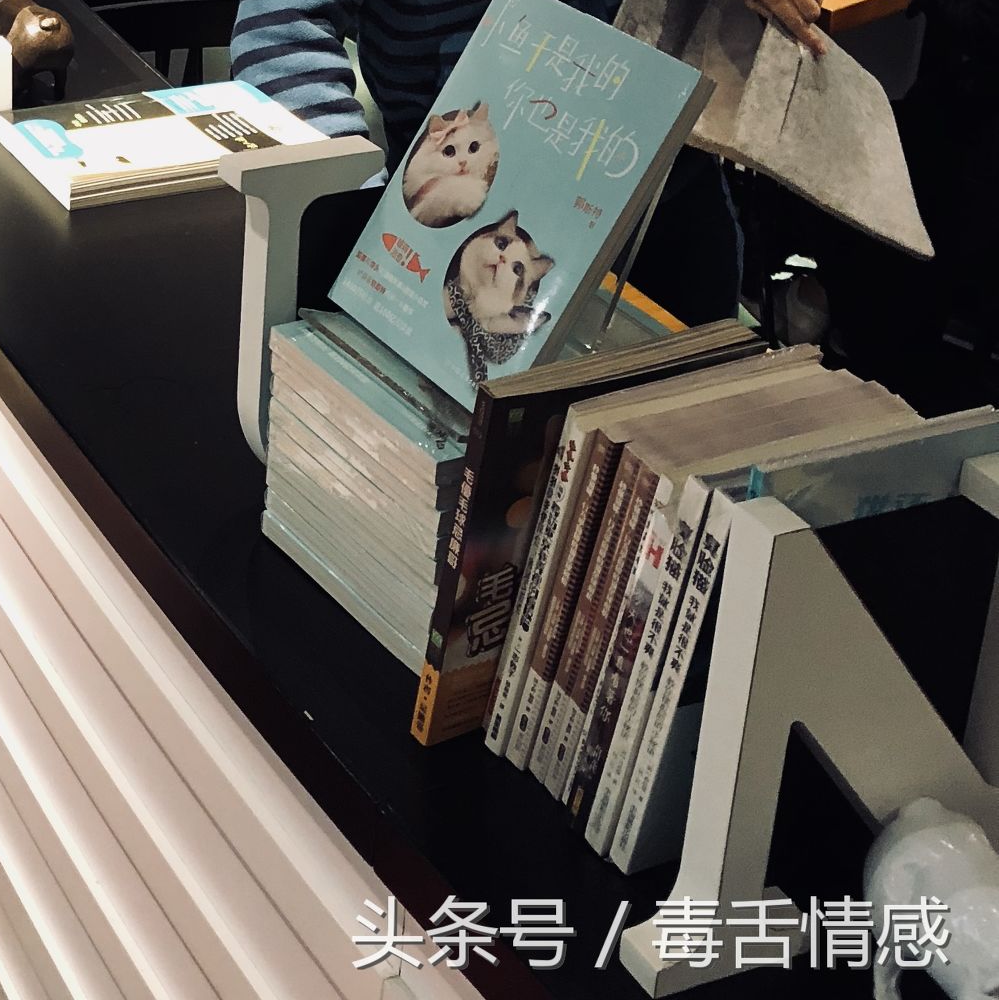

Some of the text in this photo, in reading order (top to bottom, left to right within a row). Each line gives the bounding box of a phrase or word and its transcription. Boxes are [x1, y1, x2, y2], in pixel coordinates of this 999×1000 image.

[502, 78, 640, 182] 你也是我的
